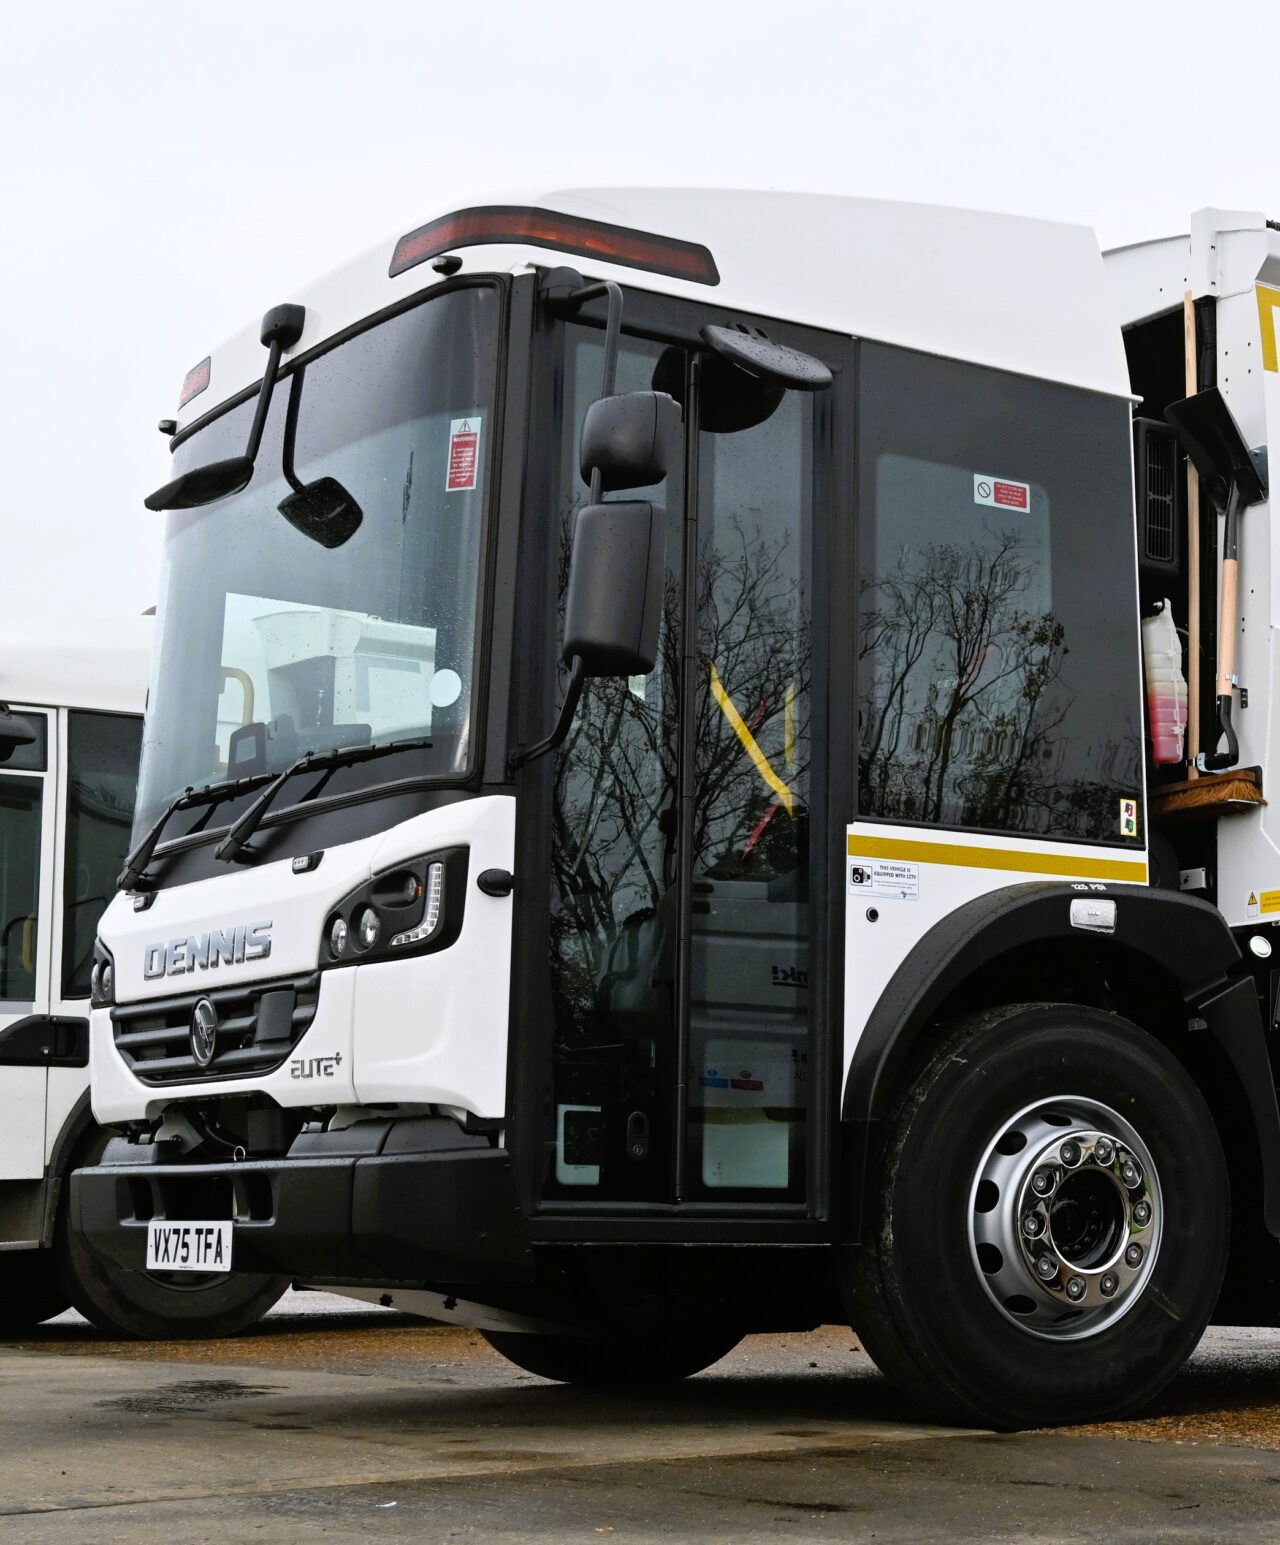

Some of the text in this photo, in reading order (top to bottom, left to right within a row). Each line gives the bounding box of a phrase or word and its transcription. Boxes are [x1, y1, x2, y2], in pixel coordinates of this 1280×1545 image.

[144, 920, 273, 981] DENNIS
[154, 1228, 223, 1264] VX75 TFA
